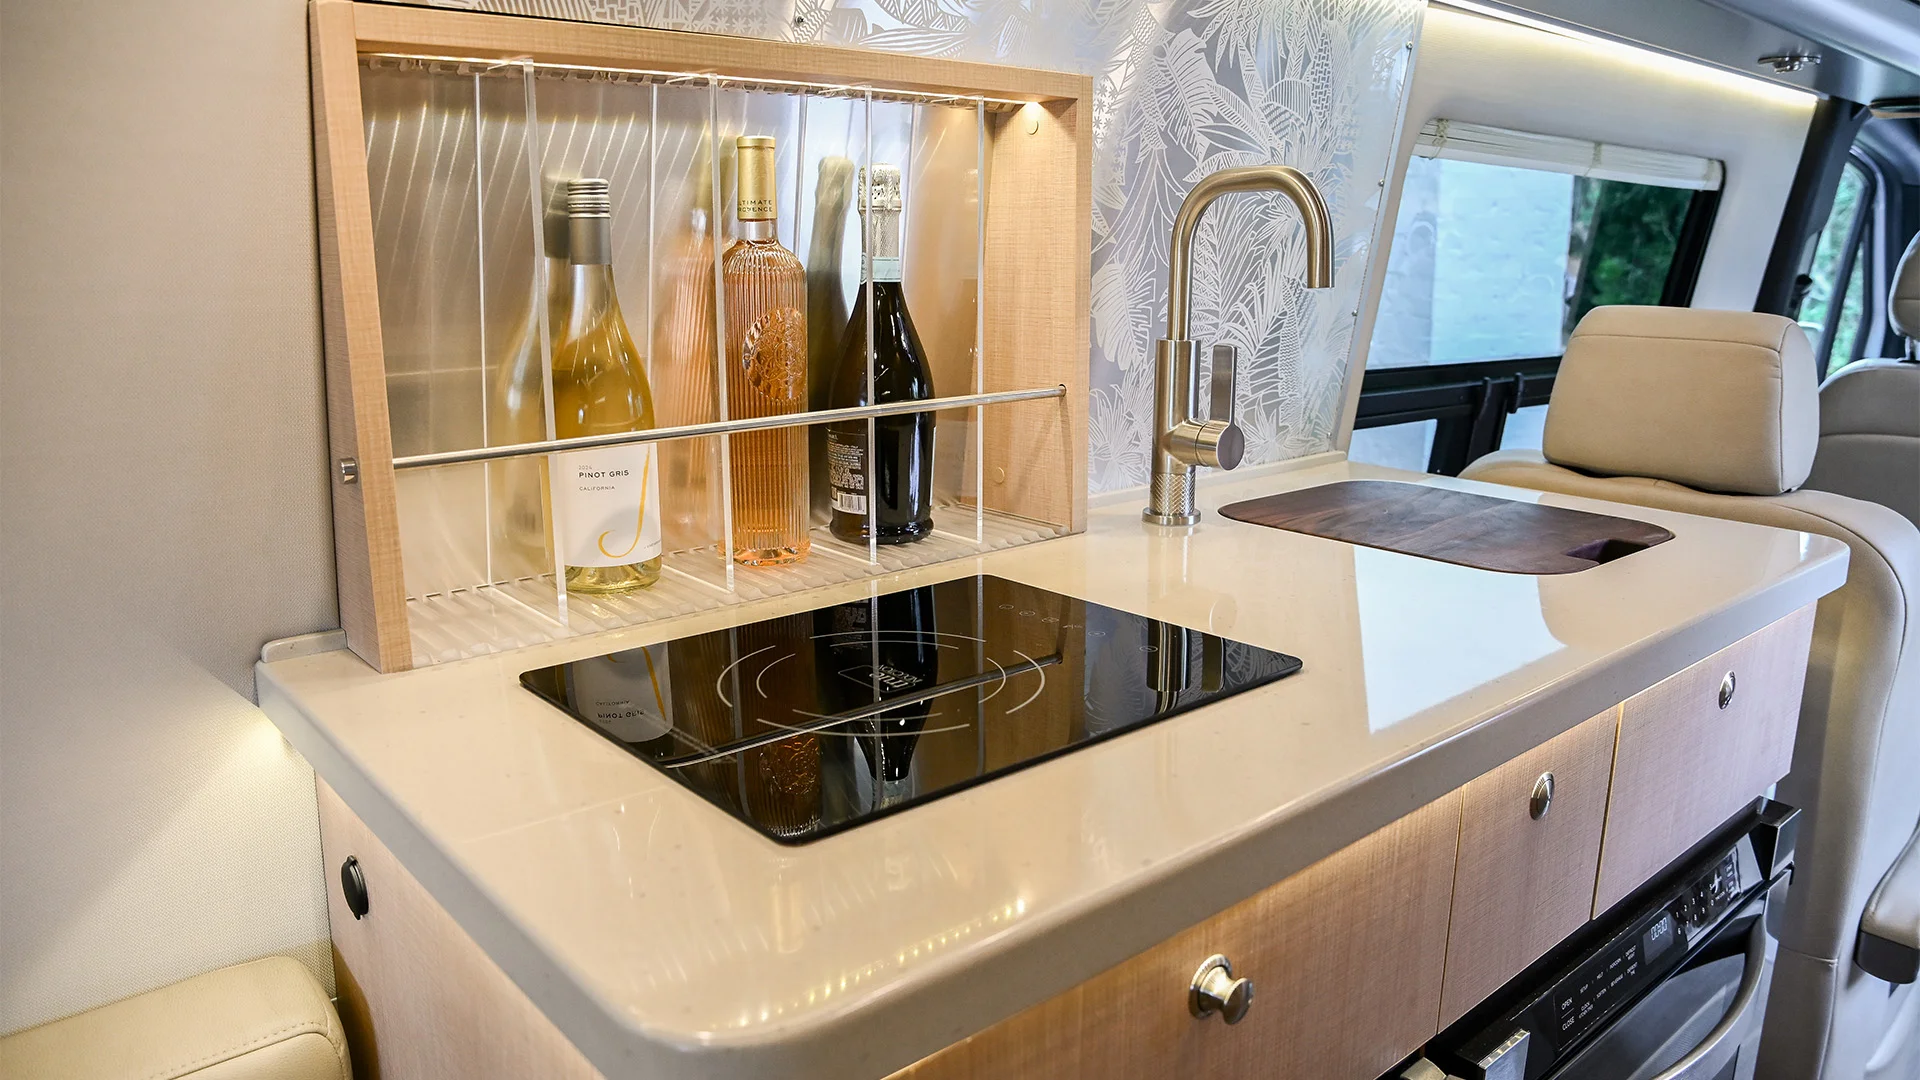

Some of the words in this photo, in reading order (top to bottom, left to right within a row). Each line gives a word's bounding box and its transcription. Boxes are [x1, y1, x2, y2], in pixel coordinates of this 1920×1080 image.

[608, 470, 630, 478] GRIS
[1561, 997, 1573, 1011] OPEN
[1562, 1016, 1575, 1031] CLOSE
